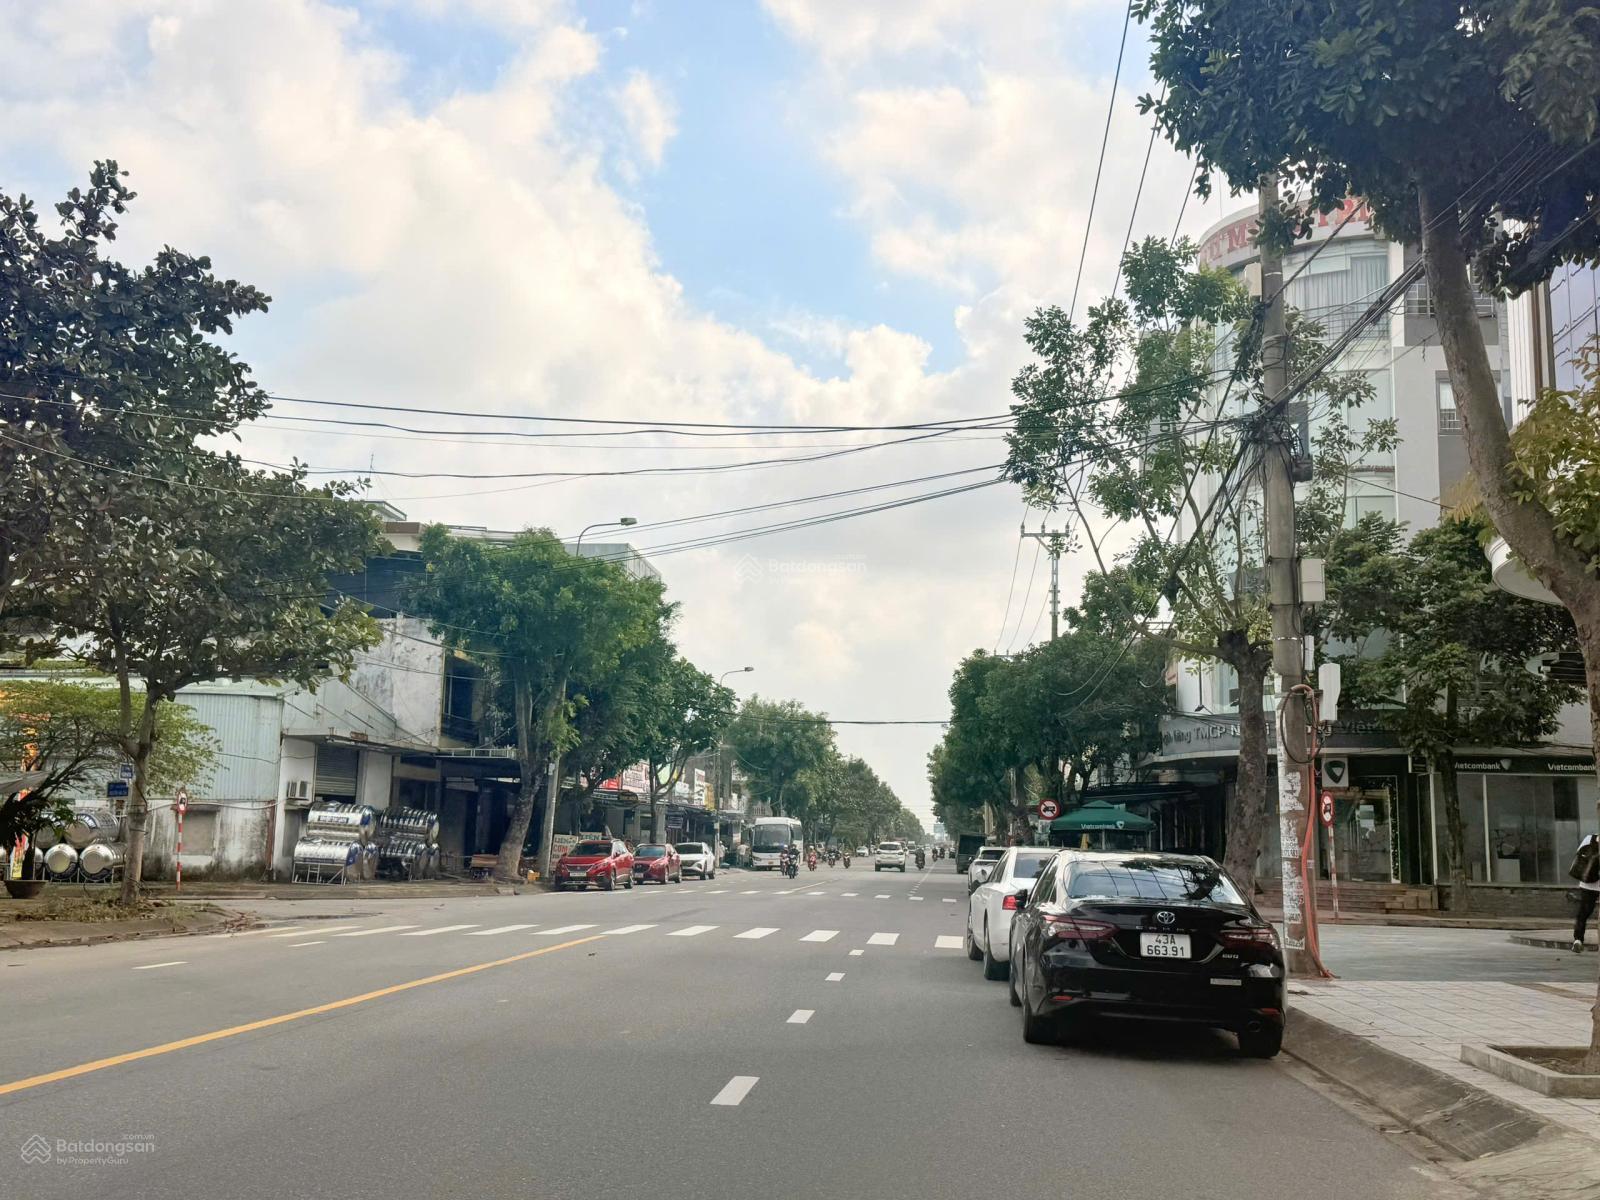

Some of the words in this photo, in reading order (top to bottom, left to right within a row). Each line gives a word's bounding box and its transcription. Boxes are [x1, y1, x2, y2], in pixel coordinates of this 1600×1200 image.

[1194, 724, 1227, 740] TMCP
[1155, 935, 1176, 945] 43A
[1147, 945, 1185, 956] 663.91
